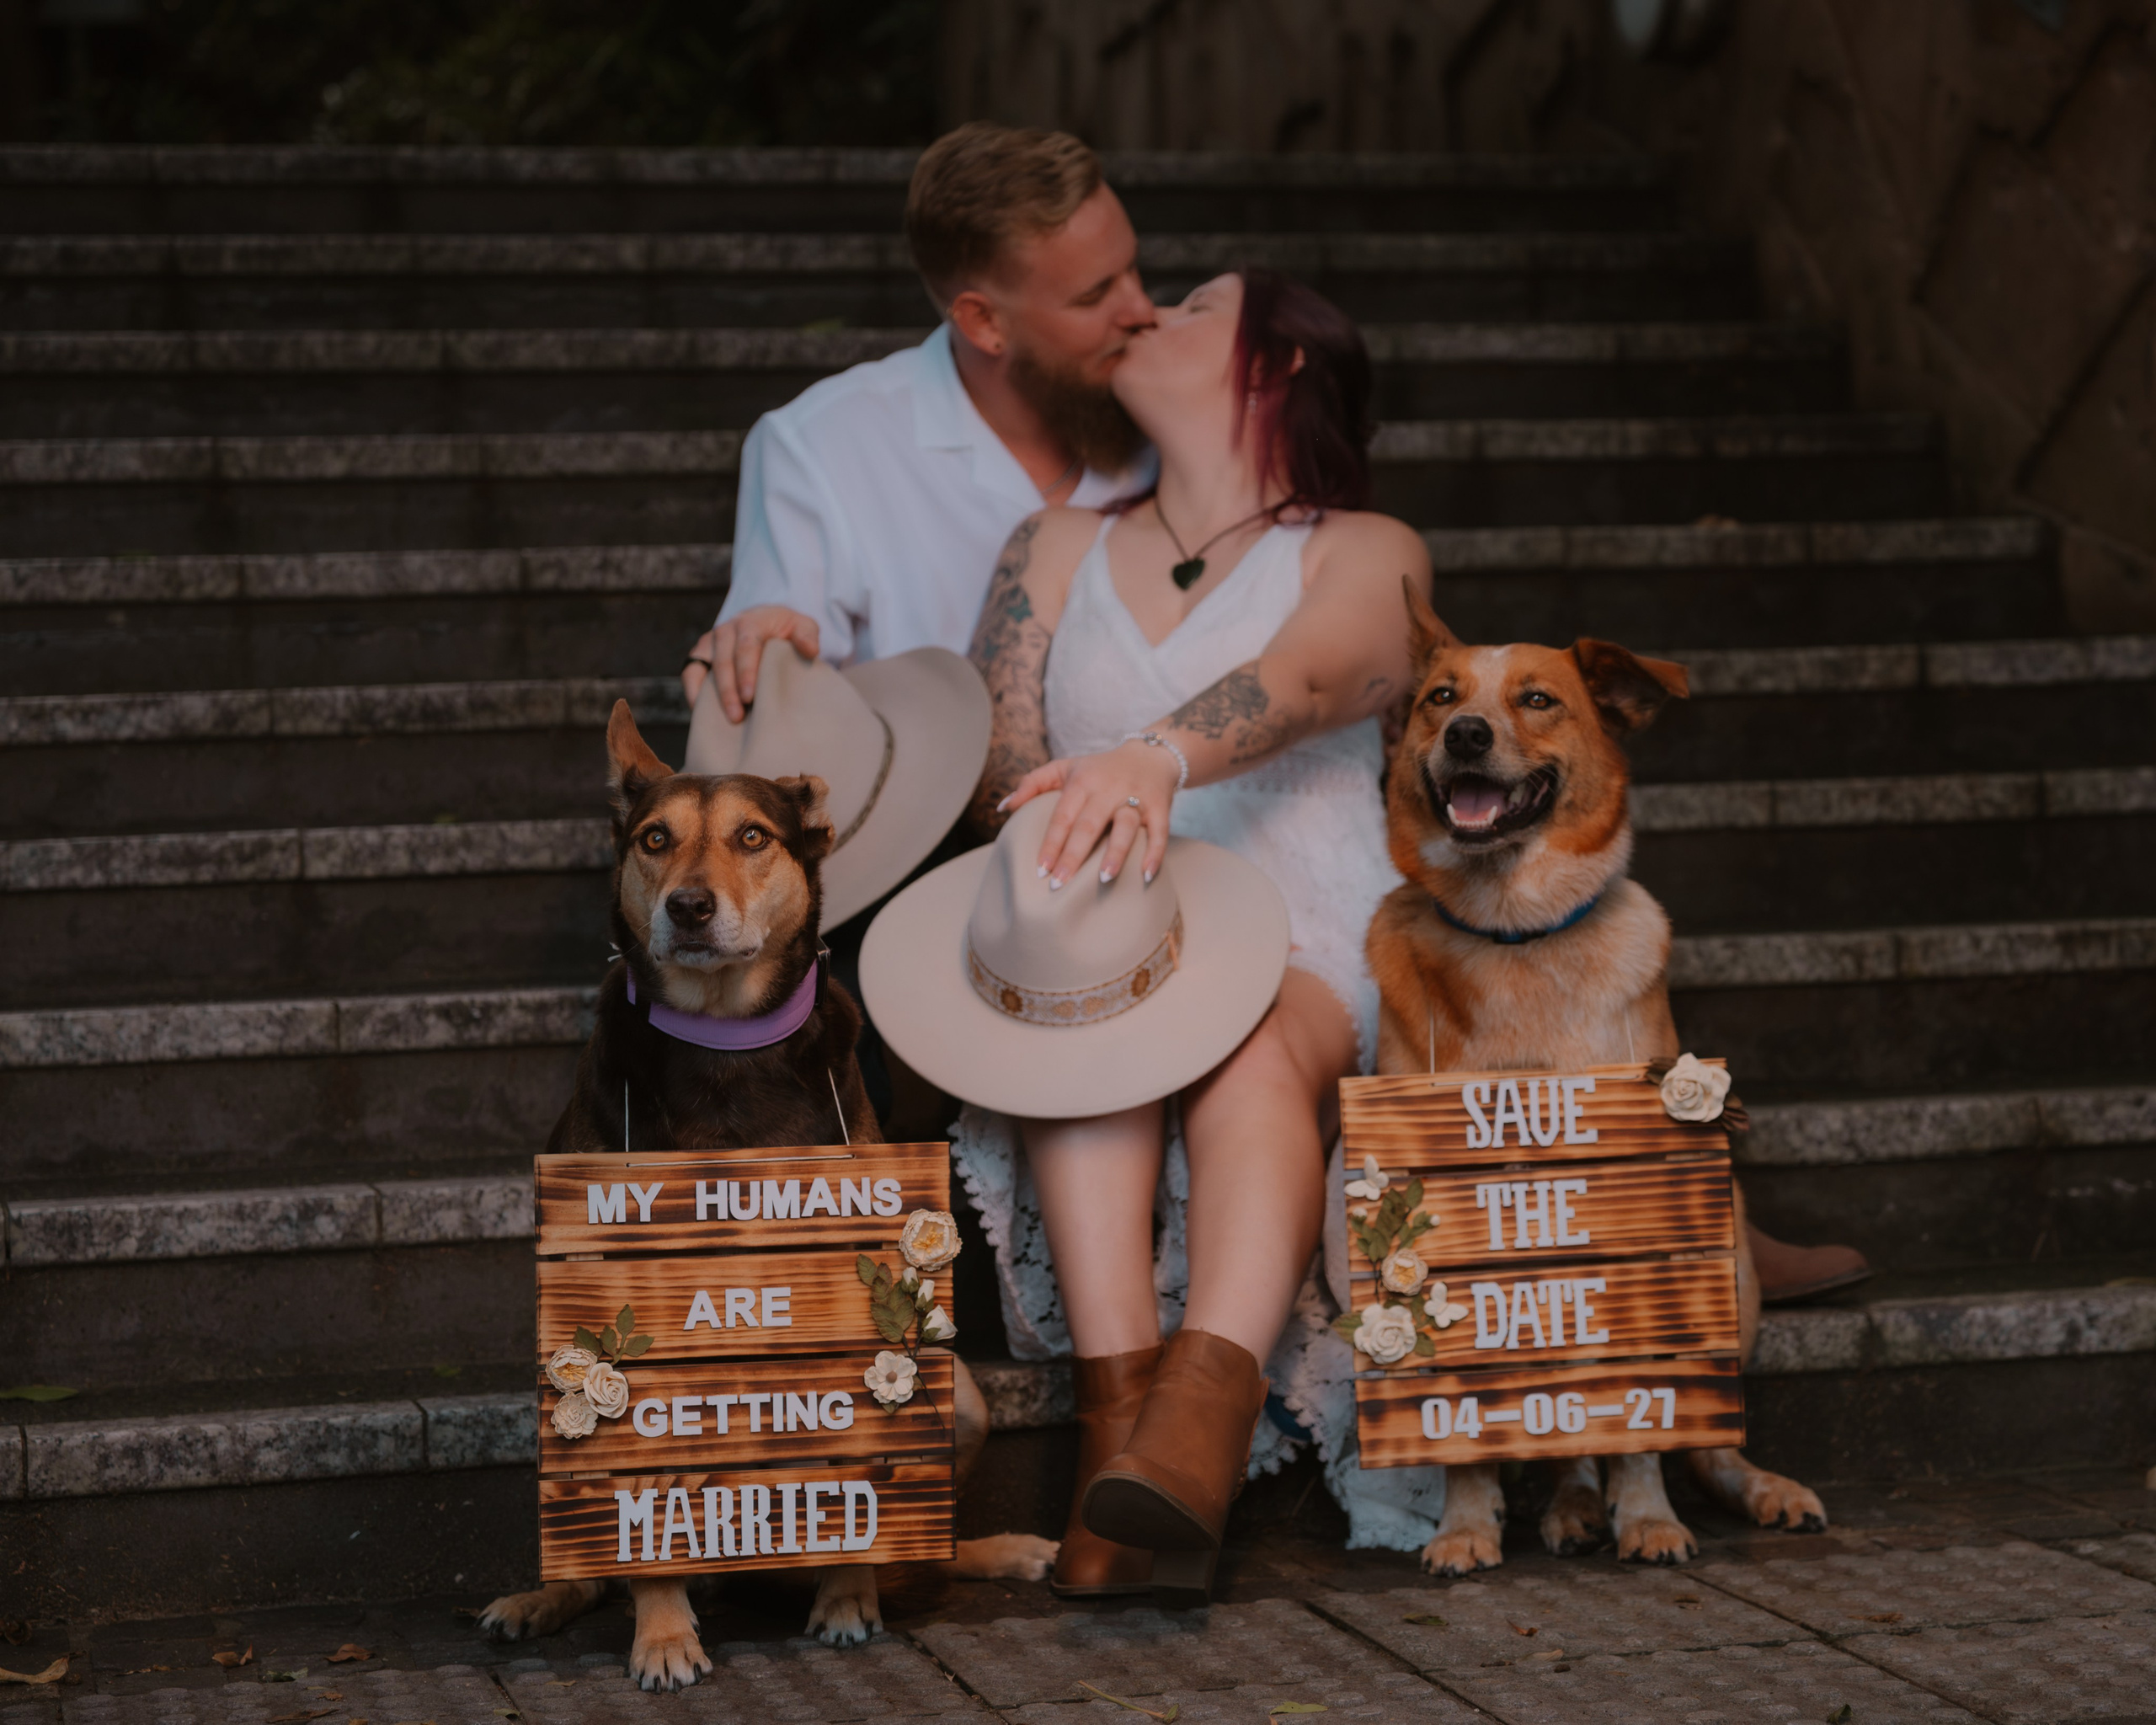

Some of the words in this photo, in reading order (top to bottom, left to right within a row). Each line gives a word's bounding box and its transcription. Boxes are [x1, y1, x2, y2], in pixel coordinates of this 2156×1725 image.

[1461, 1077, 1598, 1149] SAVE
[587, 1183, 664, 1224] MY
[695, 1177, 903, 1220] HUMANS
[1476, 1179, 1590, 1250] THE
[683, 1287, 792, 1330] ARE
[1470, 1277, 1609, 1349] DATE
[632, 1391, 854, 1438] GETTING
[1421, 1387, 1677, 1439] 04-06-27
[614, 1480, 878, 1562] MARRIED
